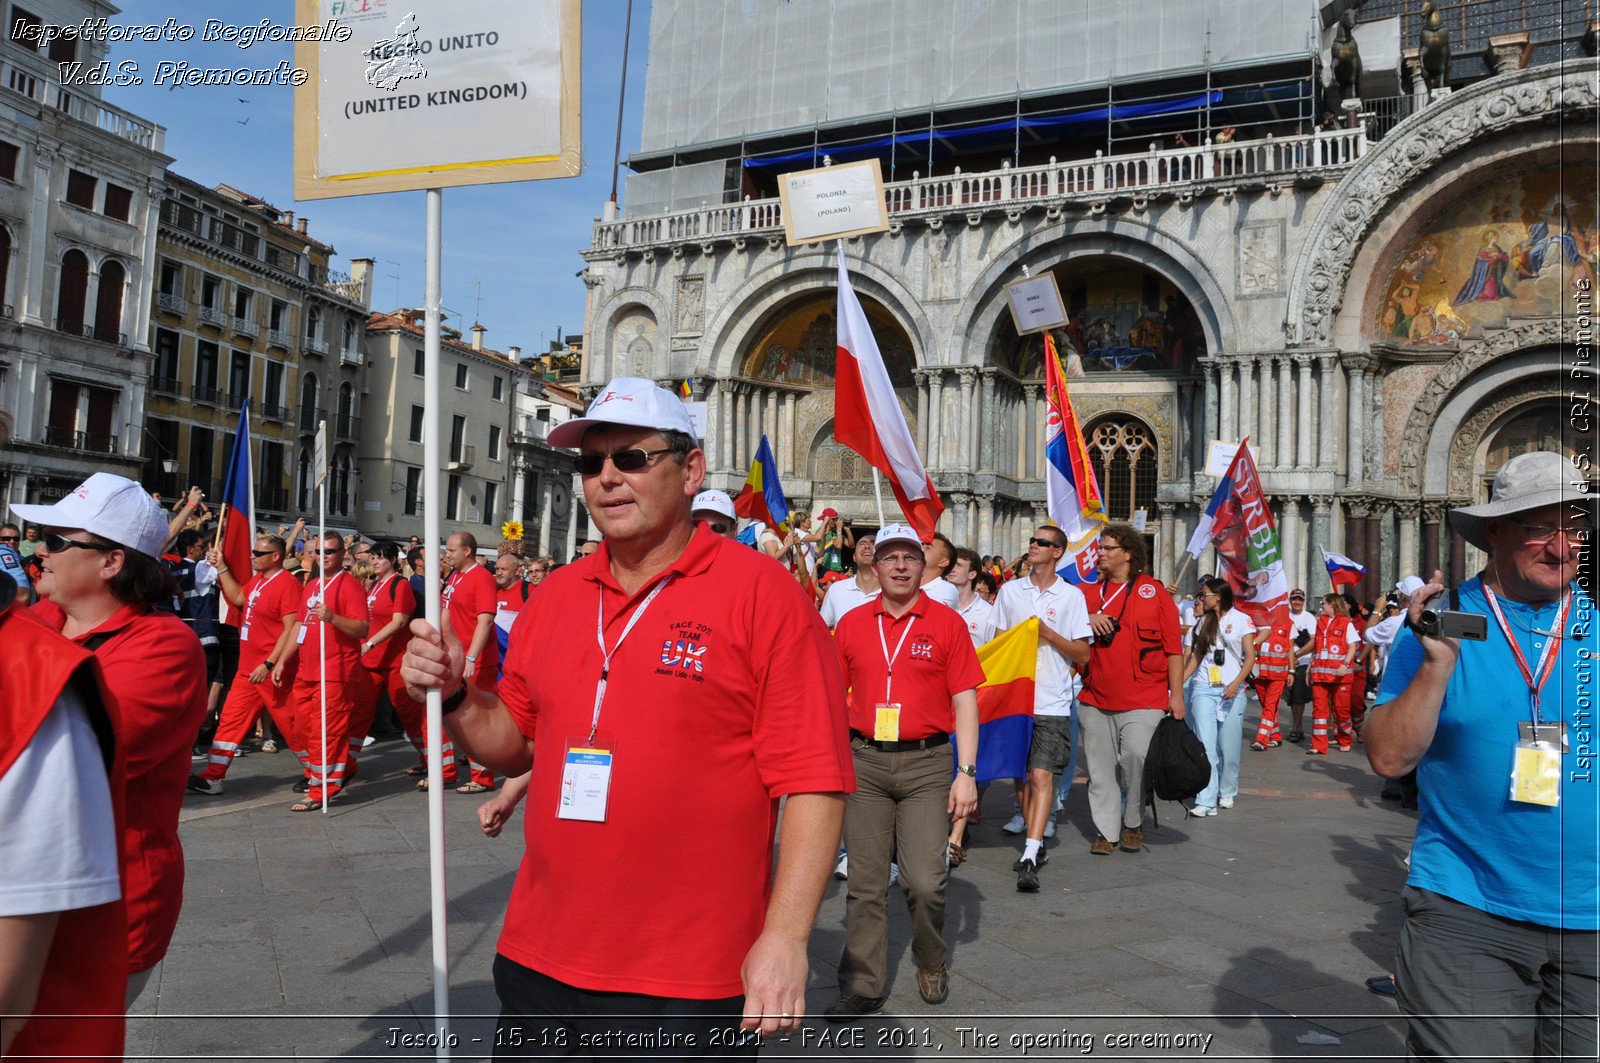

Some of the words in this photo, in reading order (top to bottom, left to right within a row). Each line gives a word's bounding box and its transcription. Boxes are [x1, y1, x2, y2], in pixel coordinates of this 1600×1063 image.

[439, 32, 499, 51] UNITO
[345, 95, 420, 119] (UNITED
[427, 82, 527, 106] KINGDOM)
[816, 190, 847, 199] POLONIA
[817, 206, 851, 218] (POLAND)
[670, 621, 693, 631] FACE
[696, 623, 712, 635] 2011
[679, 631, 701, 641] TEAM
[661, 640, 708, 672] UK
[910, 643, 933, 657] UK
